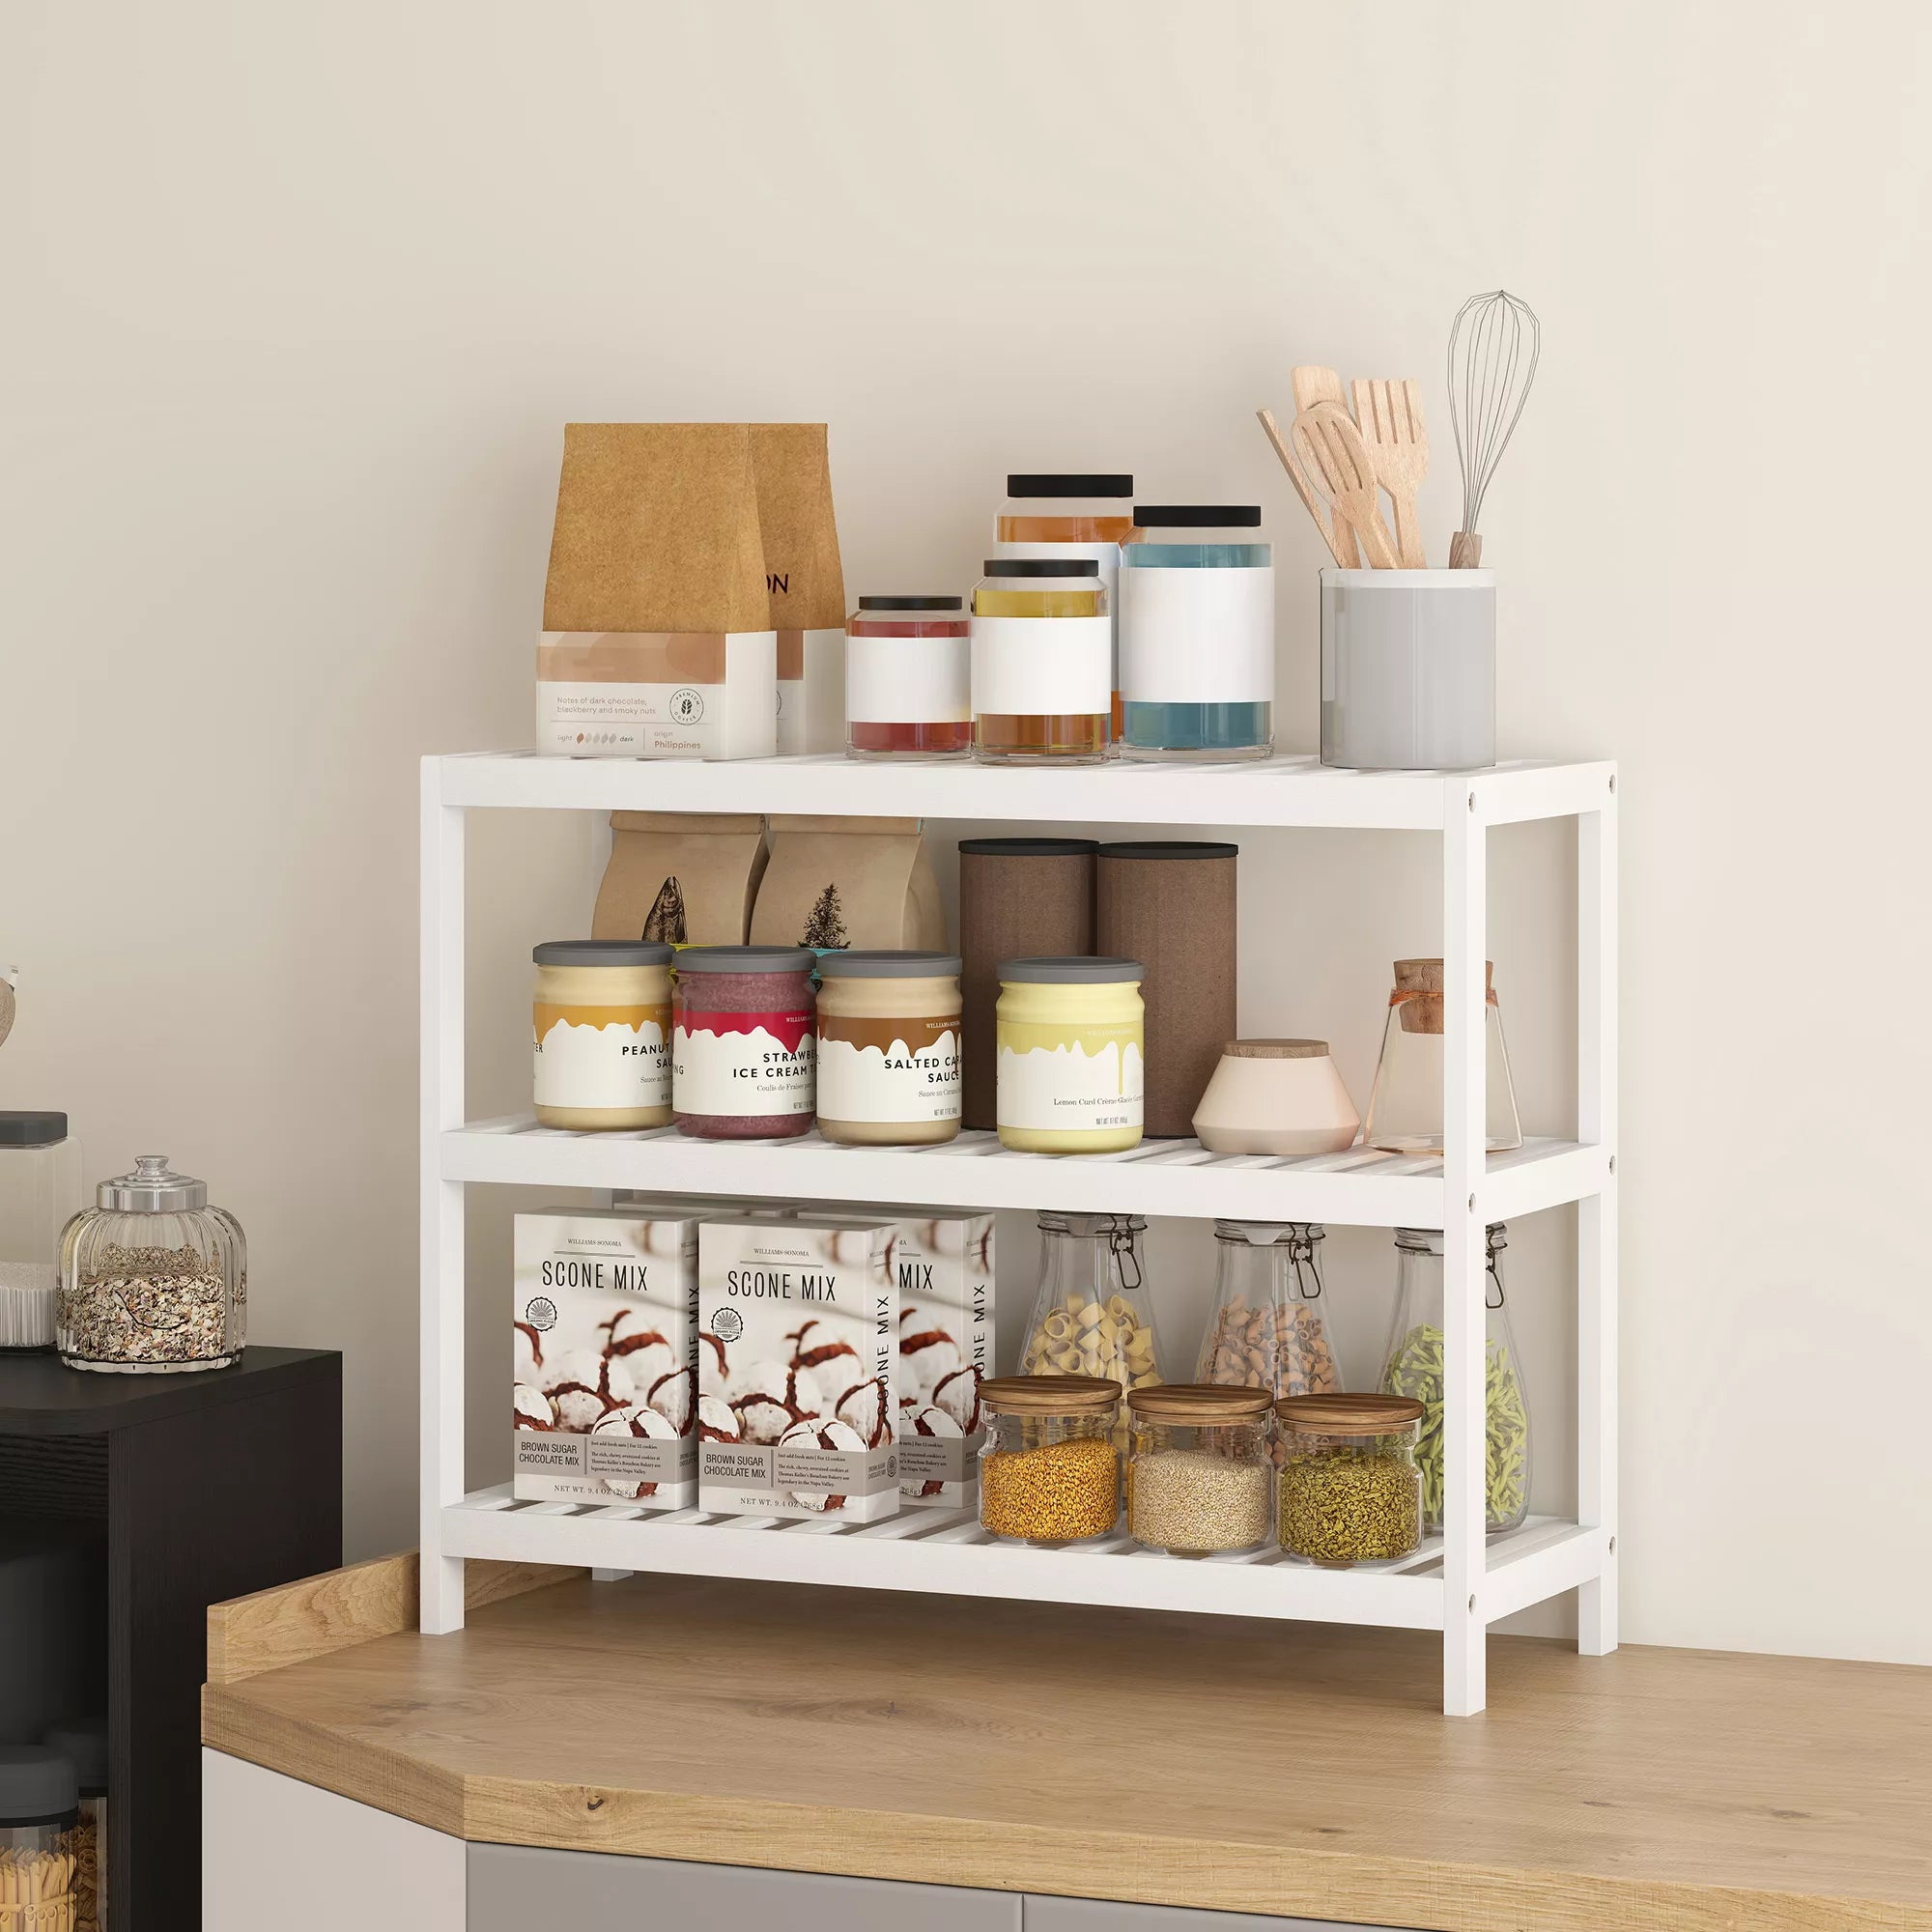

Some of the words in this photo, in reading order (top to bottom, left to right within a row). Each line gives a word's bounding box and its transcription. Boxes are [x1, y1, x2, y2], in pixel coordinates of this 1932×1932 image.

[675, 692, 699, 705] PREMIUM
[654, 741, 700, 750] Philippines
[622, 1043, 669, 1055] PEANUT
[884, 1058, 939, 1068] SALTED
[733, 1068, 757, 1078] ICE
[766, 1065, 807, 1077] CREAM
[927, 1070, 959, 1083] SAUCE
[542, 1261, 604, 1289] SCONE
[614, 1265, 647, 1292] MIX
[899, 1264, 933, 1290] MIX
[727, 1270, 791, 1299] SCONE
[802, 1274, 836, 1301] MIX
[689, 1287, 698, 1324] MIX
[974, 1285, 985, 1322] MIX
[877, 1296, 889, 1335] MIX
[521, 1441, 550, 1452] BROWN
[552, 1444, 578, 1454] SUGAR
[519, 1453, 563, 1465] CHOCOLATE
[565, 1456, 580, 1465] MIX
[706, 1454, 734, 1464] BROWN
[737, 1456, 763, 1466] SUGAR
[704, 1465, 749, 1477] CHOCOLATE
[752, 1469, 766, 1479] MIX
[801, 1501, 823, 1510] (268g)
